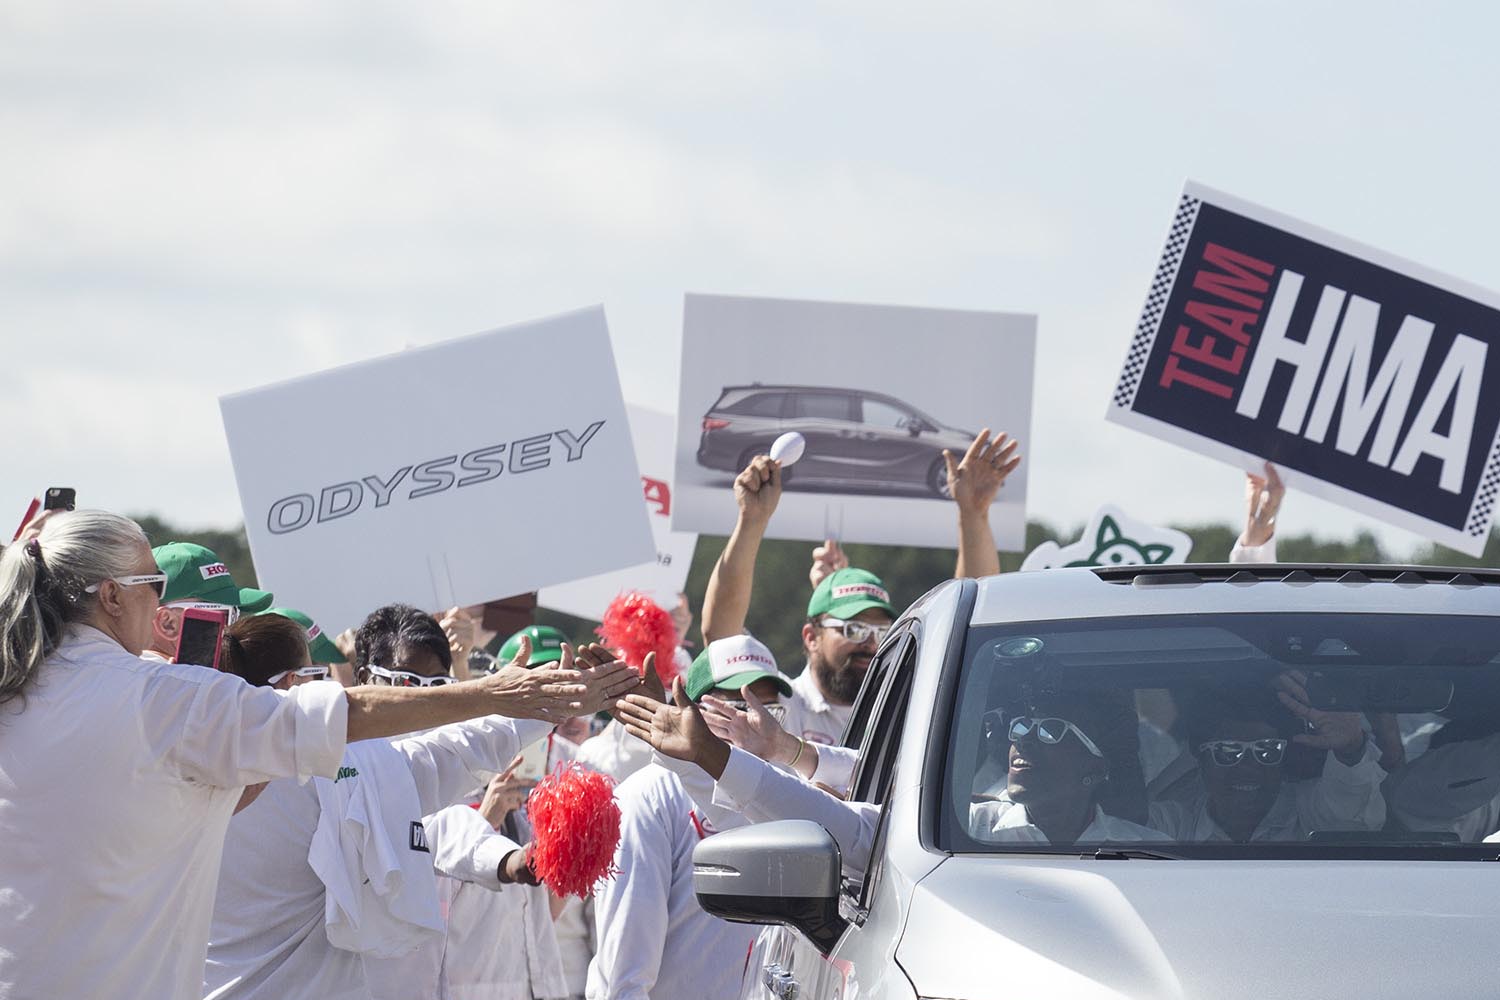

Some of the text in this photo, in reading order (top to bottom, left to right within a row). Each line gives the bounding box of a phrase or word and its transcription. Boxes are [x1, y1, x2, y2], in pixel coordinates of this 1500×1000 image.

[1159, 242, 1276, 398] TEAM
[1235, 269, 1488, 495] HMA
[266, 420, 606, 536] ODYSSEY
